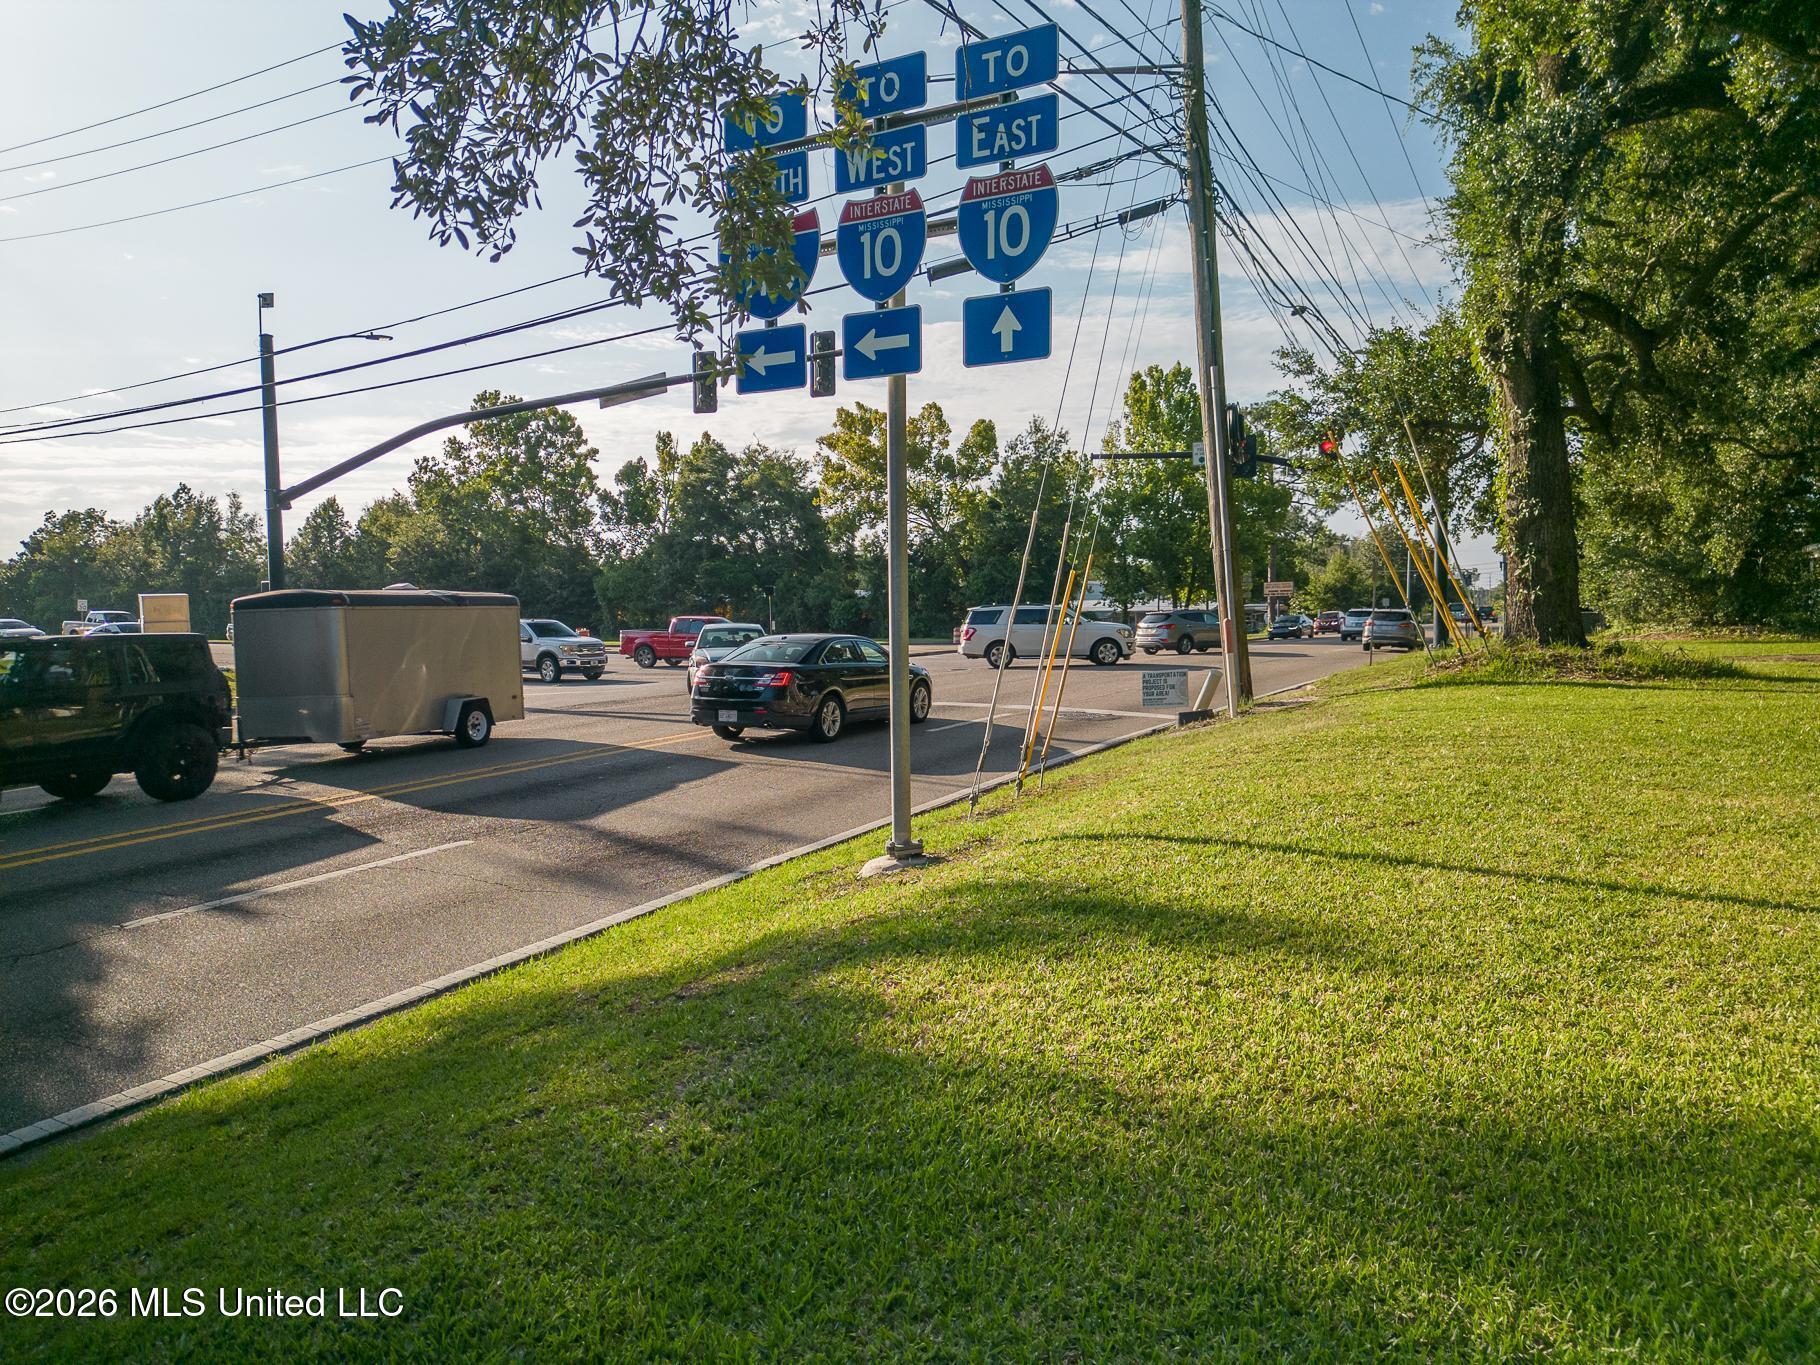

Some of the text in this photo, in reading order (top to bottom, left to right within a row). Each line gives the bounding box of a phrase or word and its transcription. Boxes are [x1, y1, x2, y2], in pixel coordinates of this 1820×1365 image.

[981, 44, 1029, 83] TO
[858, 72, 900, 107] TO
[972, 114, 1041, 158] EAST
[844, 141, 916, 184] WEST
[972, 171, 1042, 196] INTERSTATE
[981, 193, 1033, 210] MISSISSIPPI
[849, 195, 912, 219] INTERSTATE
[858, 216, 904, 232] MISSISSIPPI
[983, 204, 1031, 260] 10
[860, 227, 902, 279] 10
